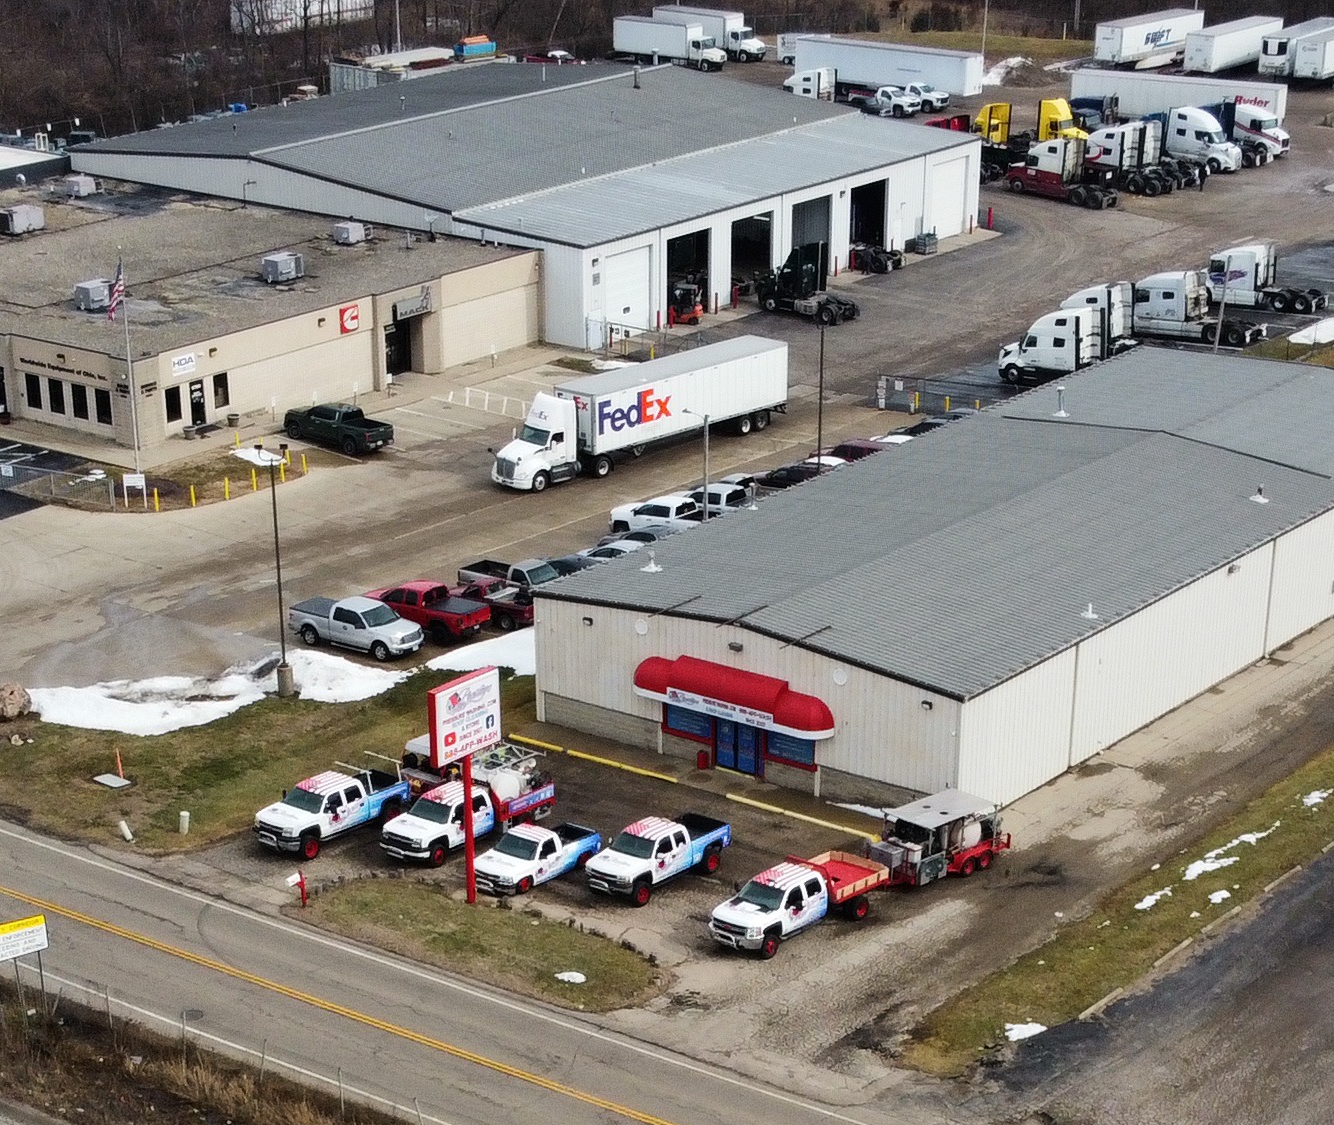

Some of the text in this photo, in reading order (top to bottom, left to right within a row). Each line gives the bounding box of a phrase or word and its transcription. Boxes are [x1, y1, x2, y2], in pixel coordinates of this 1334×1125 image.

[1234, 95, 1270, 108] Ryder
[399, 305, 428, 318] MACK
[20, 357, 47, 369] Worldwide
[48, 362, 75, 375] Equipment
[598, 388, 672, 436] FedEx
